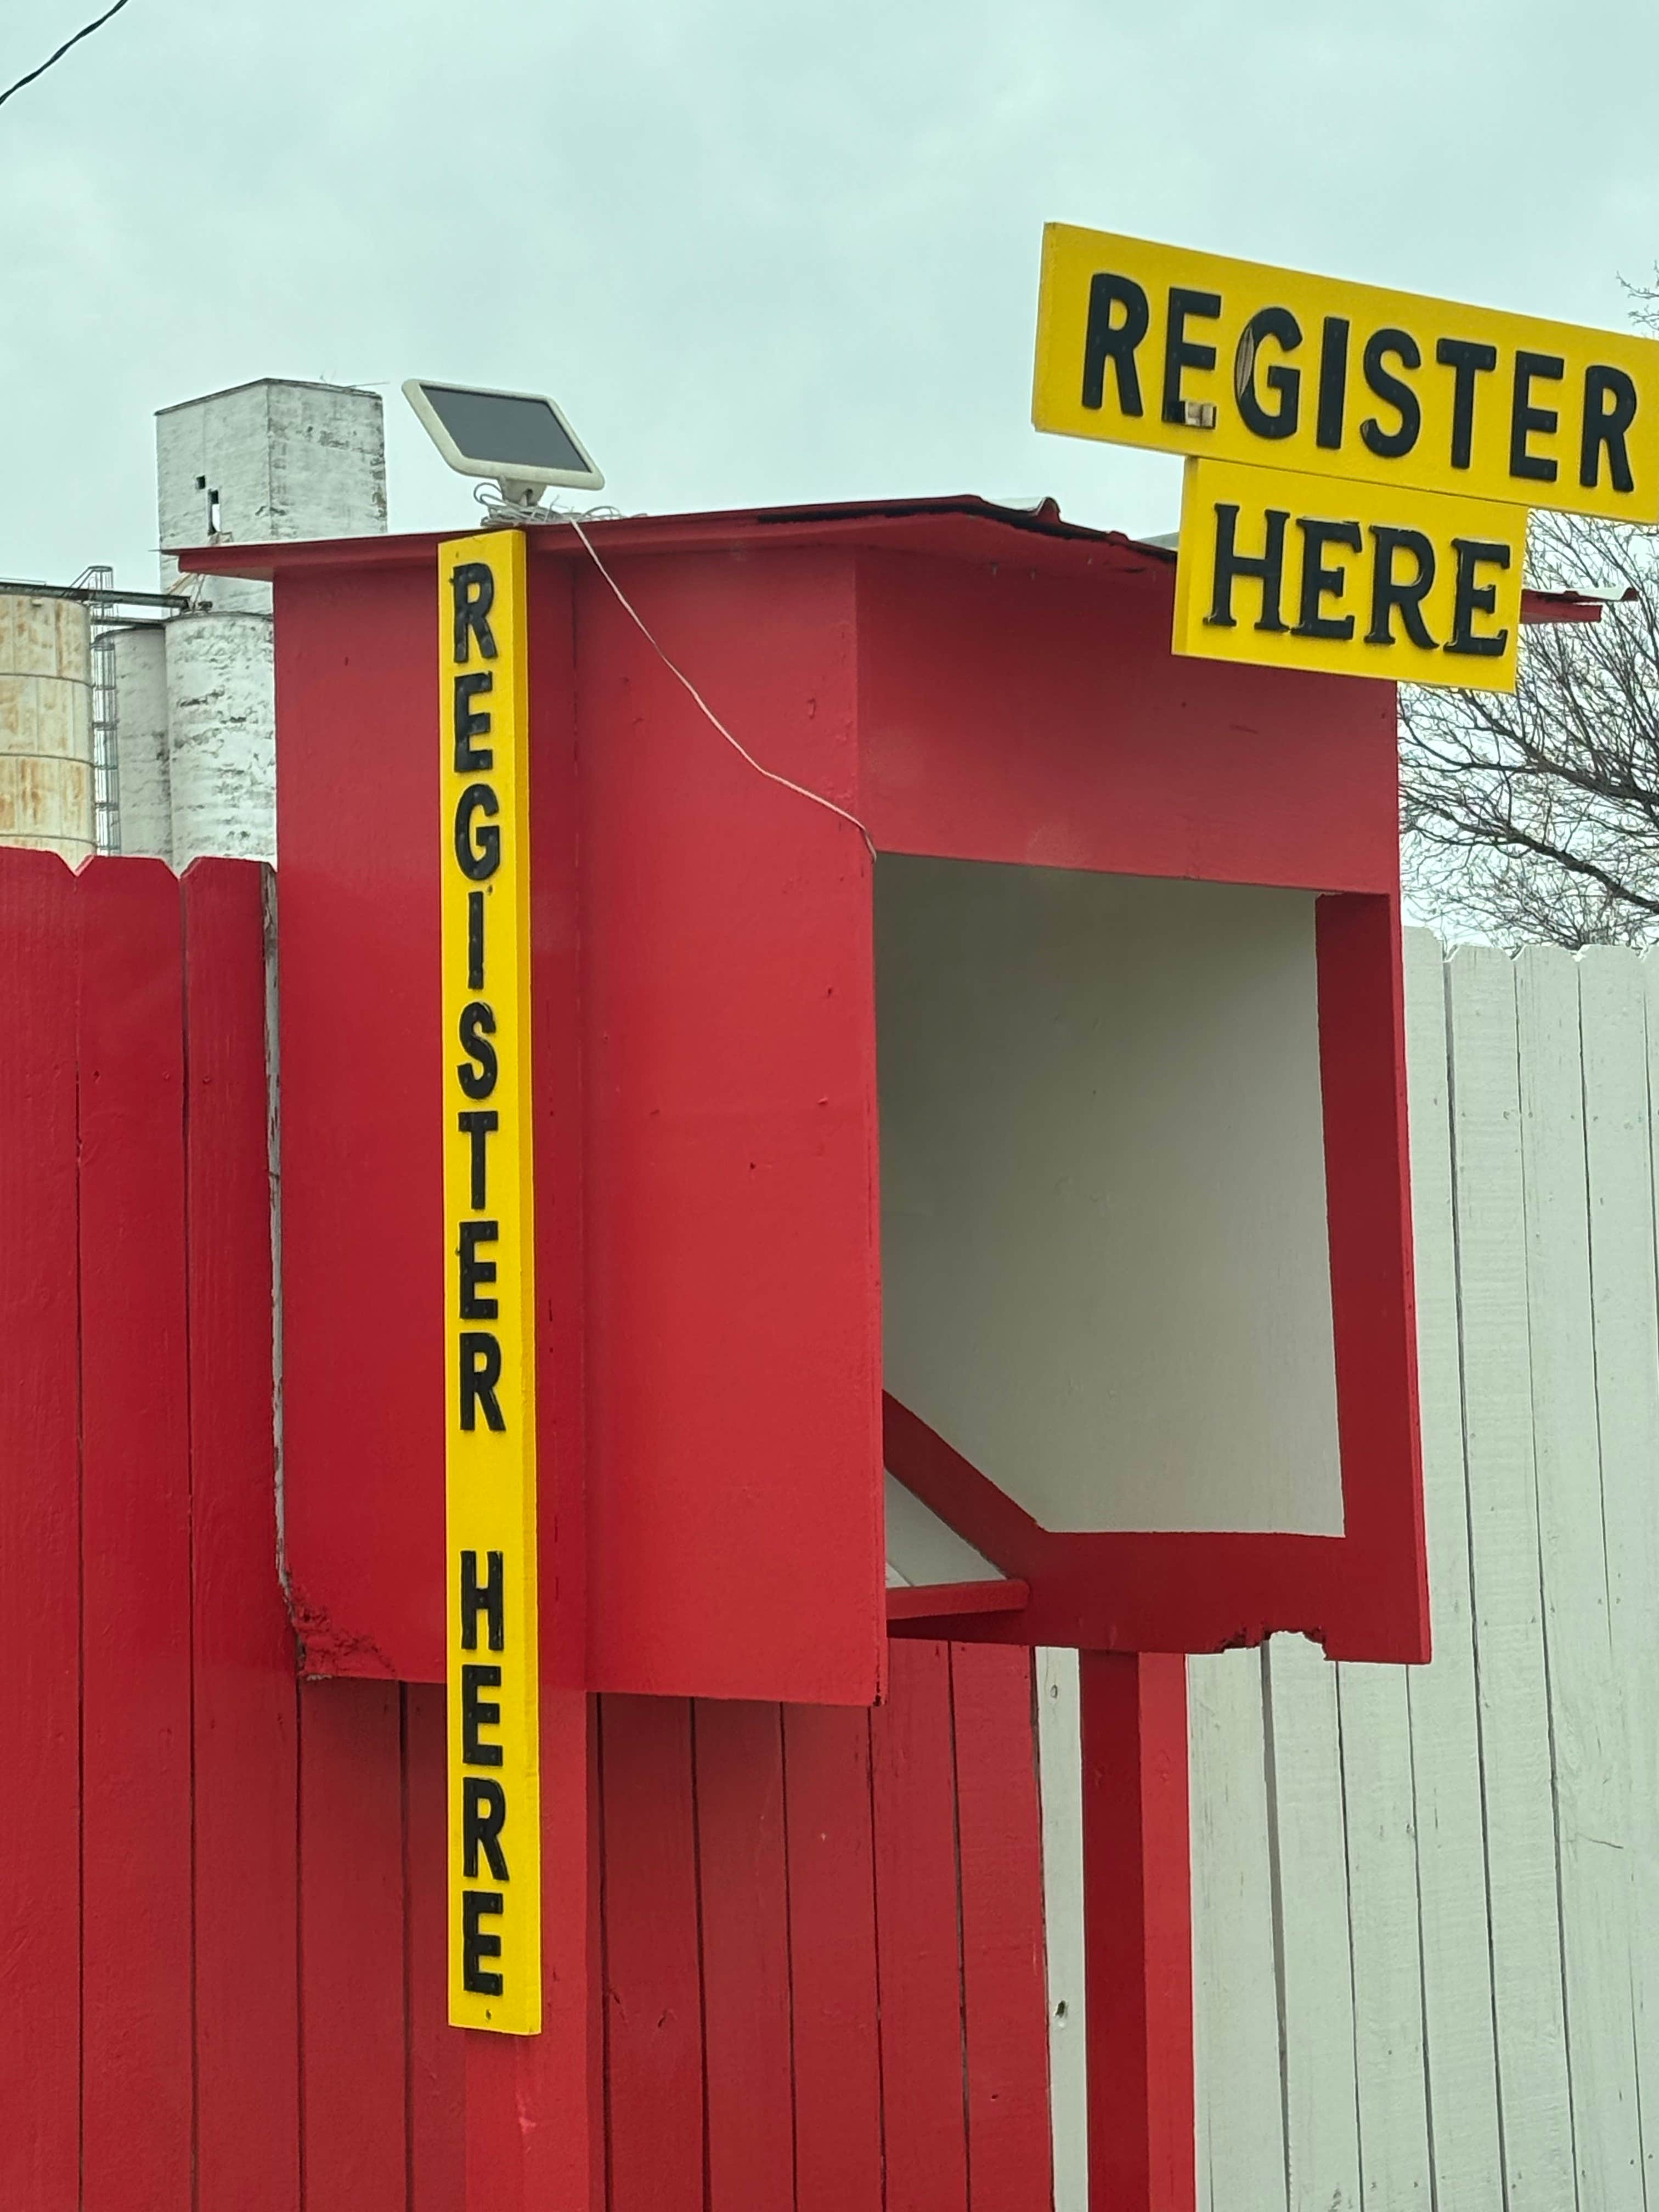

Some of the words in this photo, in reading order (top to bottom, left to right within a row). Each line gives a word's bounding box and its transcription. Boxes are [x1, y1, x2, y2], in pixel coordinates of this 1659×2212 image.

[1082, 273, 1637, 493] REGISTER
[1204, 503, 1510, 657] HERE
[453, 563, 505, 1431] REGISTER
[461, 1550, 509, 1996] HERE
